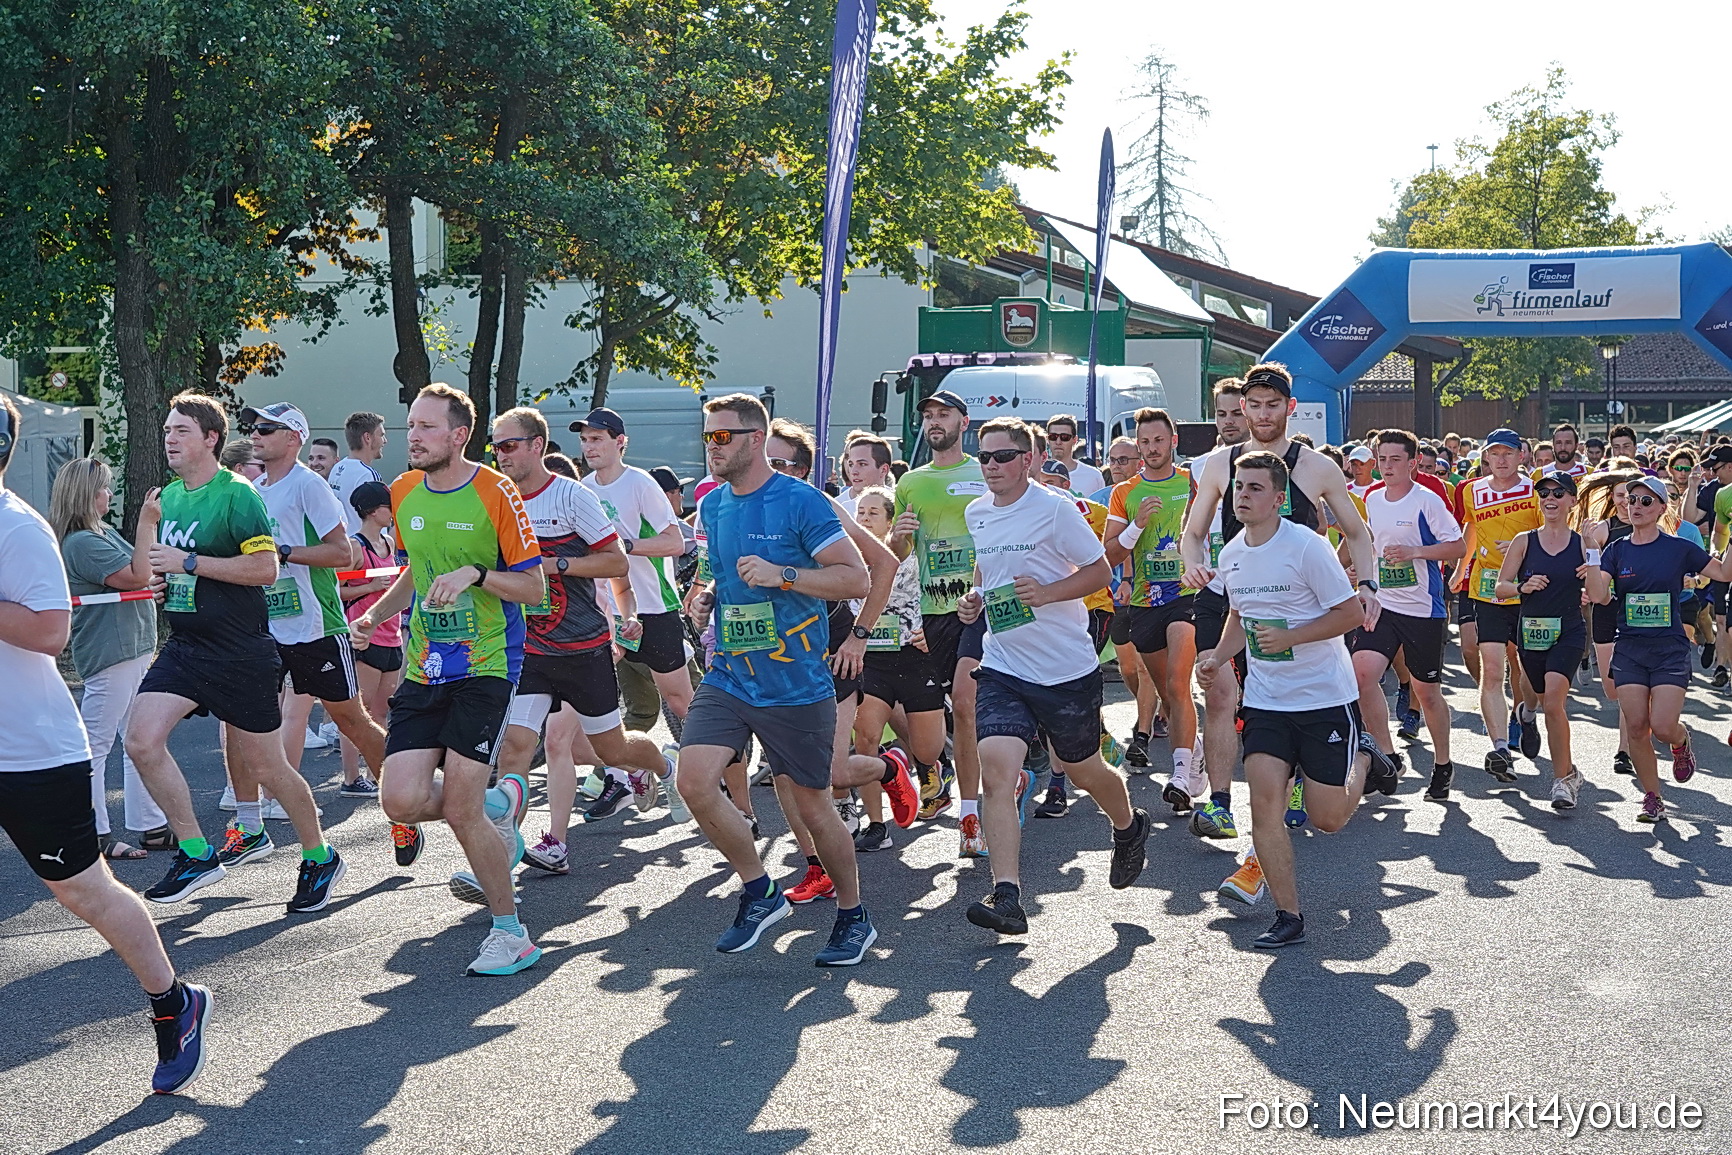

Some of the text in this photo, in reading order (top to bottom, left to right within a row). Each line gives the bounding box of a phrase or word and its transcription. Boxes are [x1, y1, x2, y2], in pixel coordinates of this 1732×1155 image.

[1539, 272, 1571, 281] Fischer
[1513, 288, 1614, 309] firmenlauf
[1320, 323, 1373, 335] Fischer
[1475, 501, 1535, 522] MAX BÖGL
[447, 522, 473, 530] BOCK
[1002, 544, 1036, 552] HOLZBAU
[937, 549, 963, 564] 217
[1153, 560, 1176, 572] 619
[1385, 568, 1405, 579] 313
[1260, 585, 1291, 593] HOLZBAU
[990, 598, 1020, 620] 1521
[1636, 604, 1659, 616] 494
[430, 611, 457, 628] 781
[466, 612, 475, 633] 2022
[729, 619, 766, 637] 1916
[766, 620, 776, 642] 2022
[1530, 629, 1550, 640] 480
